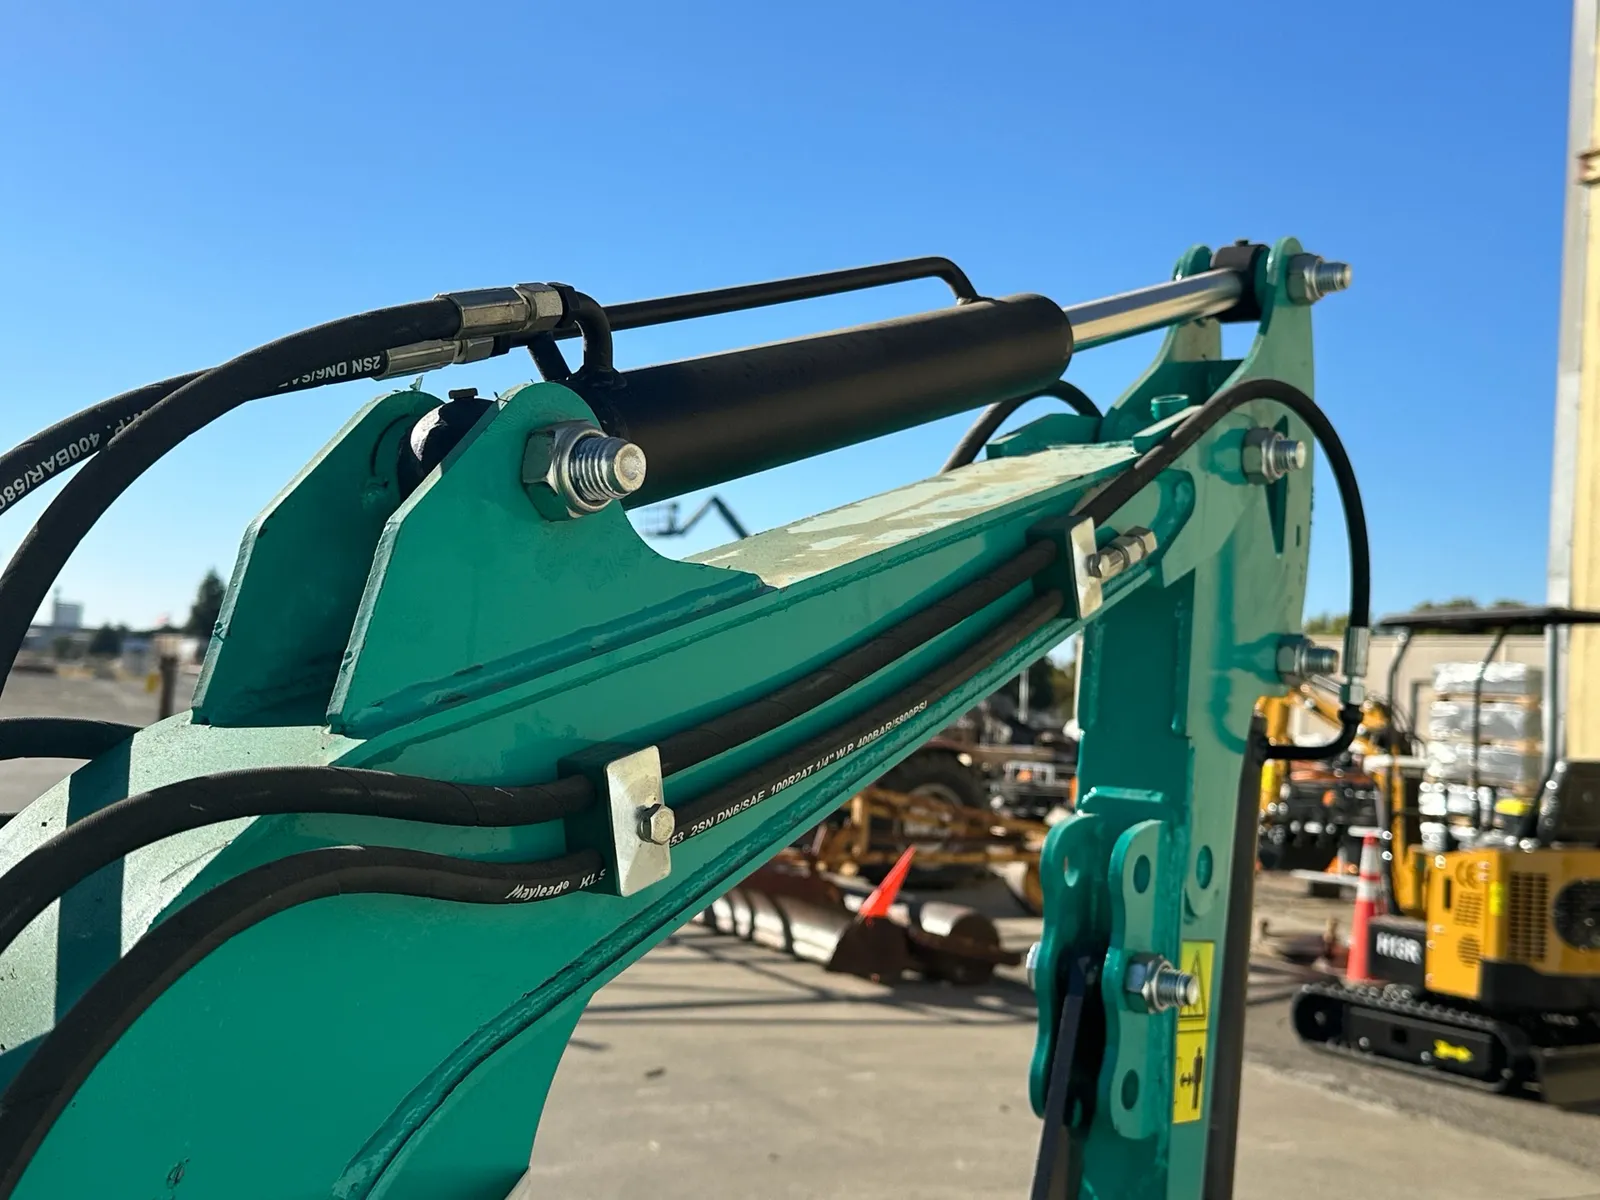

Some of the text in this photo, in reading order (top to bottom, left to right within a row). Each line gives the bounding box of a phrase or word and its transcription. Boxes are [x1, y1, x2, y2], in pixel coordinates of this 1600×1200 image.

[351, 355, 382, 375] 2SN
[690, 816, 715, 837] 2SN
[716, 790, 766, 824] DN6/SAE
[770, 764, 815, 796] 100R2AT
[856, 700, 928, 748] 400BAR/5800PSI
